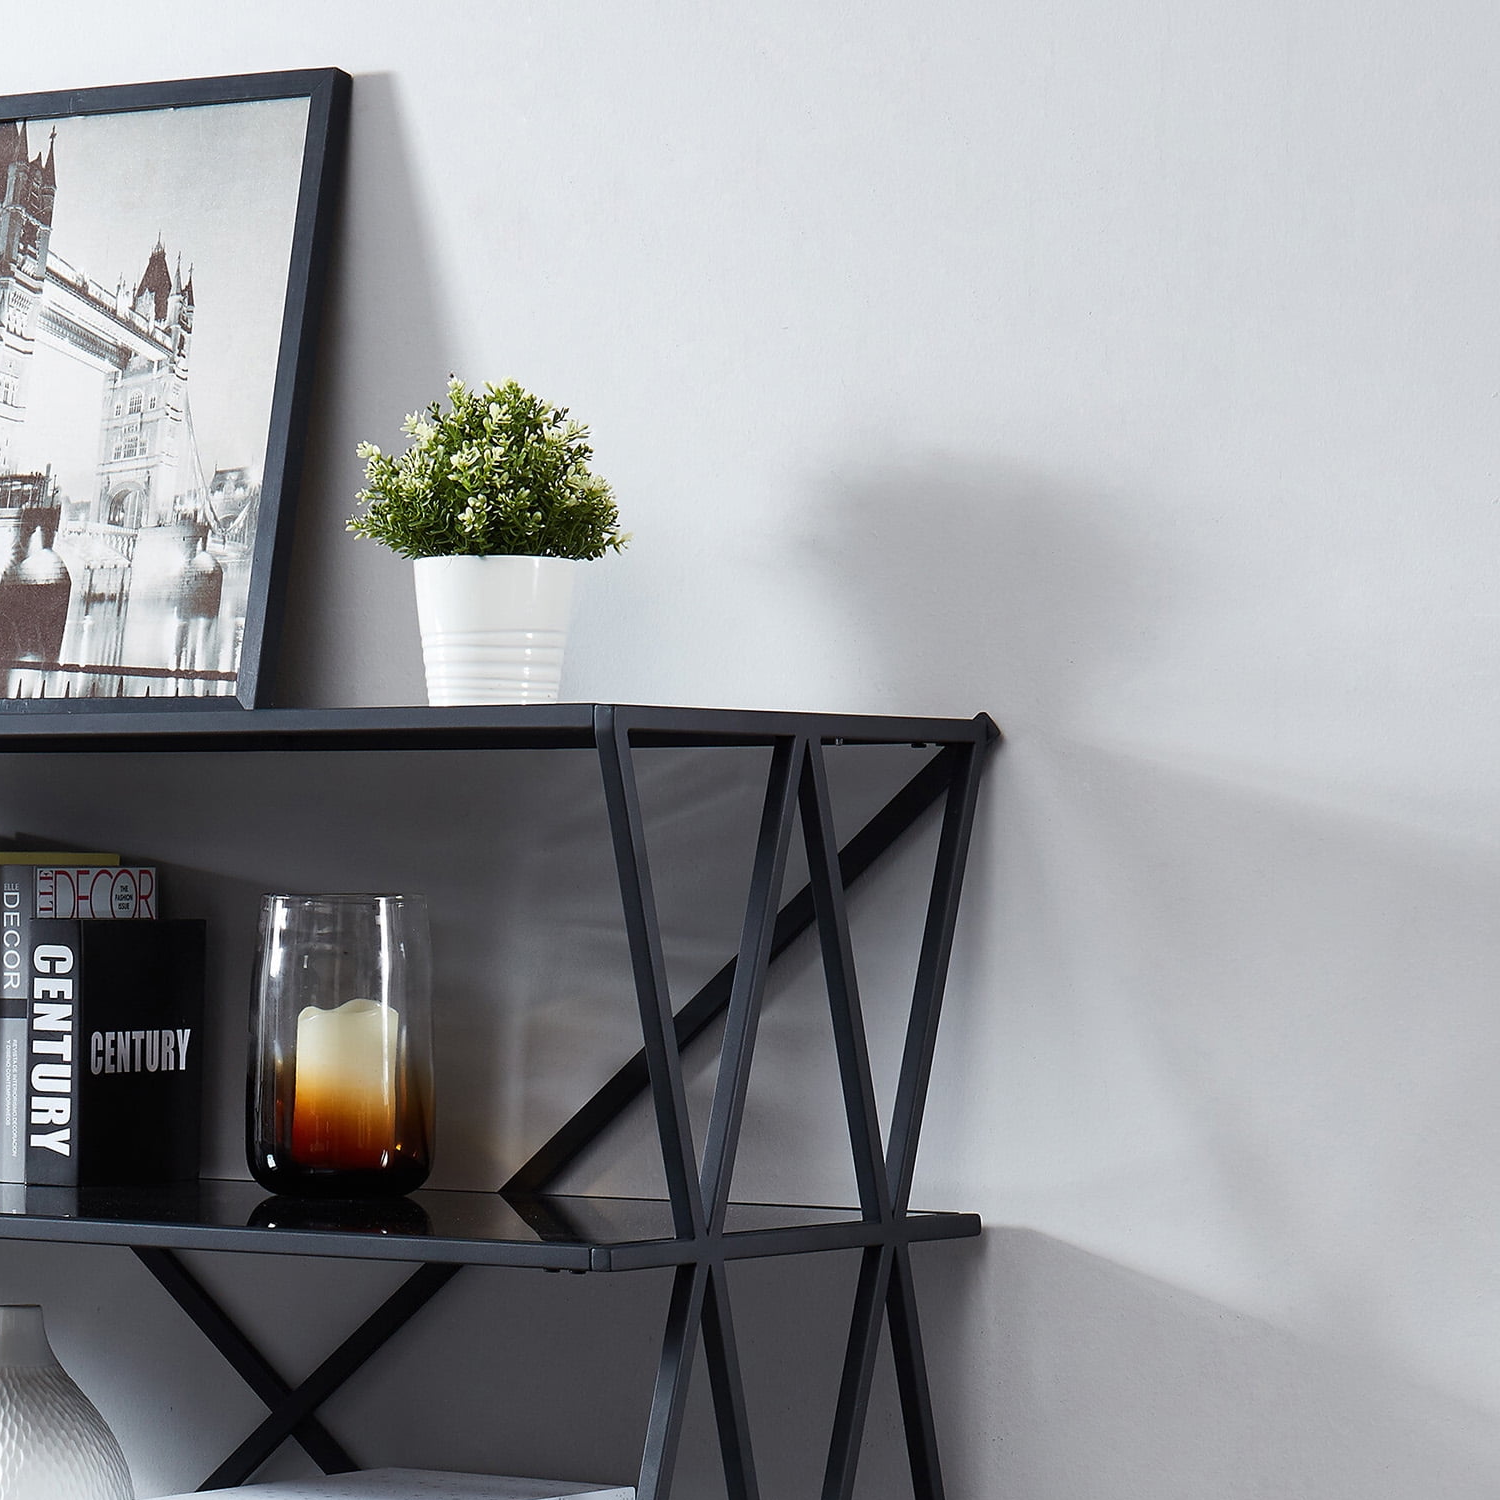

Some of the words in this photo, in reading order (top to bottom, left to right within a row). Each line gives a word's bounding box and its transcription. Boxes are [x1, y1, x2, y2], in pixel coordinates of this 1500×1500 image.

[4, 883, 19, 891] ELLE
[54, 869, 155, 918] DECOR
[2, 892, 20, 990] DECOR
[30, 943, 74, 1157] CENTURY
[90, 1029, 191, 1075] CENTURY
